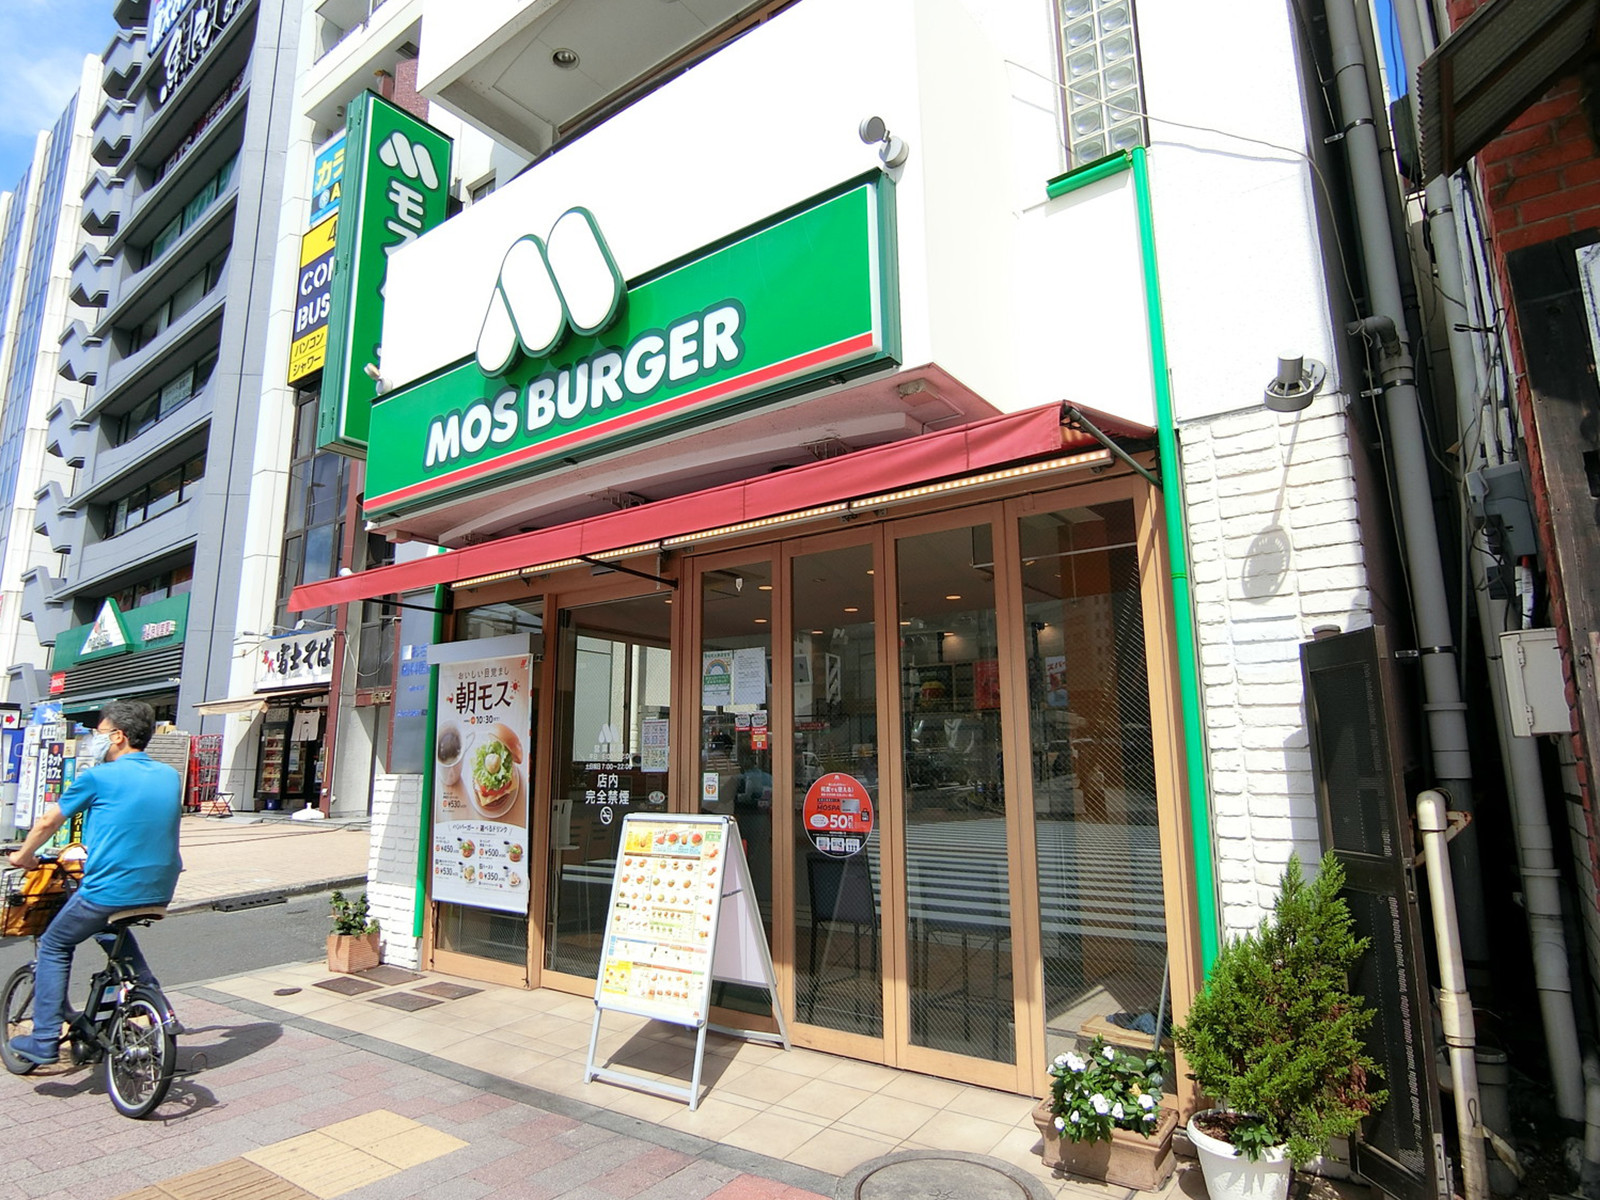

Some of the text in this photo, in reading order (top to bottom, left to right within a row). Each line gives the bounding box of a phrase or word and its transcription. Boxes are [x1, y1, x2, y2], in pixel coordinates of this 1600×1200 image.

[297, 292, 330, 332] BUS
[294, 332, 324, 357] パソコン
[293, 356, 321, 377] シャワー
[425, 306, 740, 467] MOS BURGER
[277, 637, 333, 675] 富士そば
[458, 667, 509, 680] おいしい目覚まし
[456, 681, 511, 714] 朝モス
[476, 715, 493, 724] 10:30
[597, 774, 618, 788] 店内
[448, 800, 460, 808] ¥530
[585, 790, 630, 805] 完全禁煙
[830, 814, 848, 829] 50
[441, 845, 453, 853] ¥450
[485, 849, 499, 857] ¥500
[441, 868, 453, 876] ¥530
[484, 872, 498, 881] ¥350
